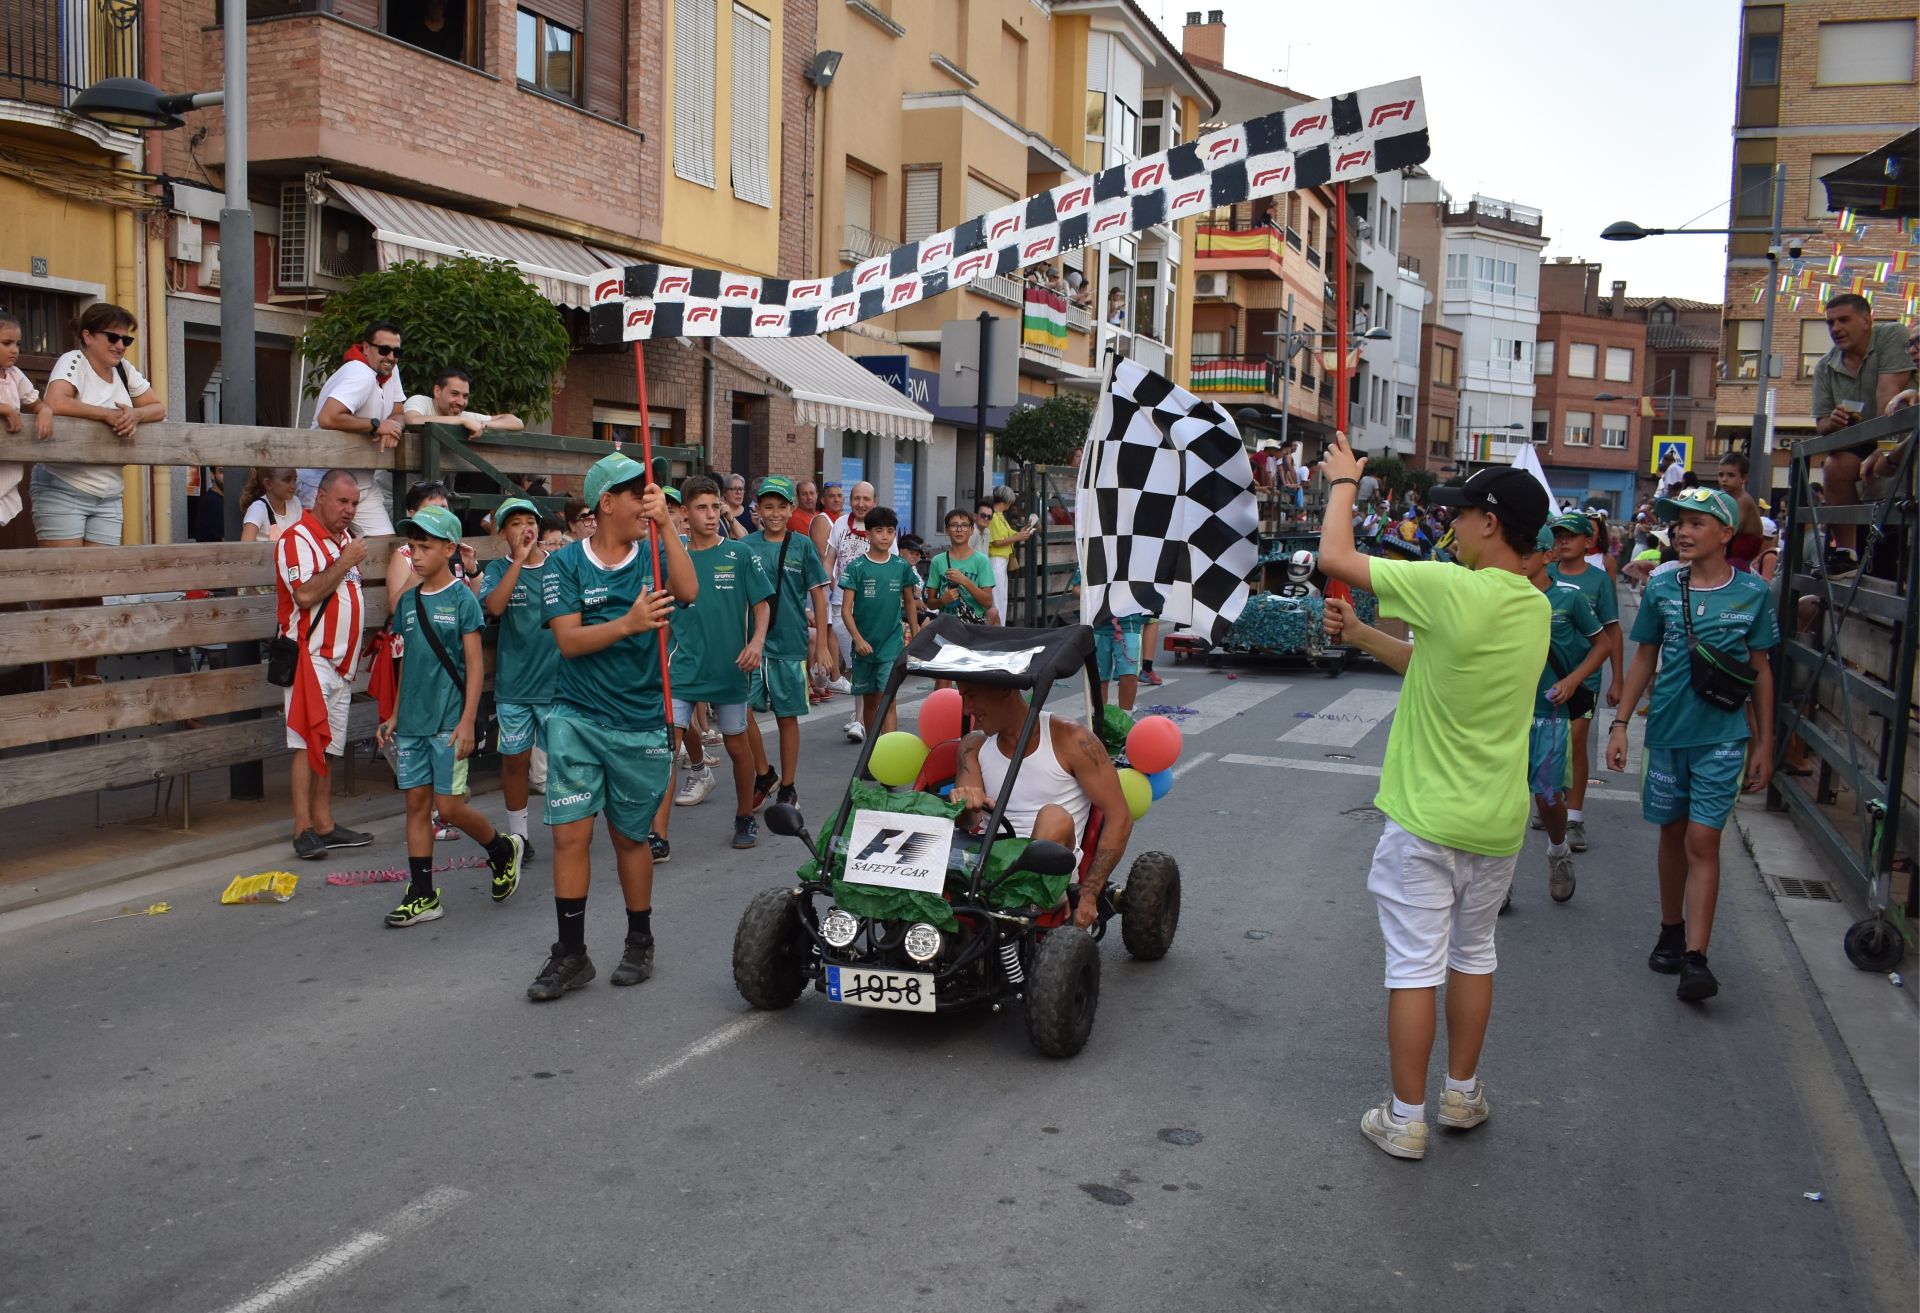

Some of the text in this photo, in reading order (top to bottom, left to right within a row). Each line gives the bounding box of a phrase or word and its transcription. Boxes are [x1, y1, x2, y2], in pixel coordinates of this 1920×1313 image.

[1370, 100, 1415, 127] F1
[1291, 115, 1327, 137] F1
[1208, 137, 1240, 160] F1
[1336, 150, 1371, 172] F1
[1132, 162, 1166, 188] F1
[1253, 165, 1291, 186] F1
[1057, 188, 1092, 212] F1
[1172, 190, 1205, 208] F1
[992, 216, 1021, 237] F1
[1095, 212, 1127, 232] F1
[922, 244, 952, 262] F1
[1024, 237, 1056, 257] F1
[34, 259, 47, 274] 26
[858, 266, 887, 284] F1
[955, 254, 993, 277] F1
[595, 278, 625, 302] F1
[658, 276, 690, 293] F1
[724, 284, 759, 300] F1
[792, 285, 822, 298] F1
[891, 282, 917, 303] F1
[628, 309, 654, 327] F1
[687, 306, 719, 321] F1
[755, 313, 785, 326] F1
[825, 303, 855, 320] F1
[1720, 611, 1755, 622] aramco
[550, 791, 592, 808] aramco
[854, 828, 942, 865] F1
[851, 861, 930, 878] SAFETY CAR
[831, 973, 922, 1006] E 1958
